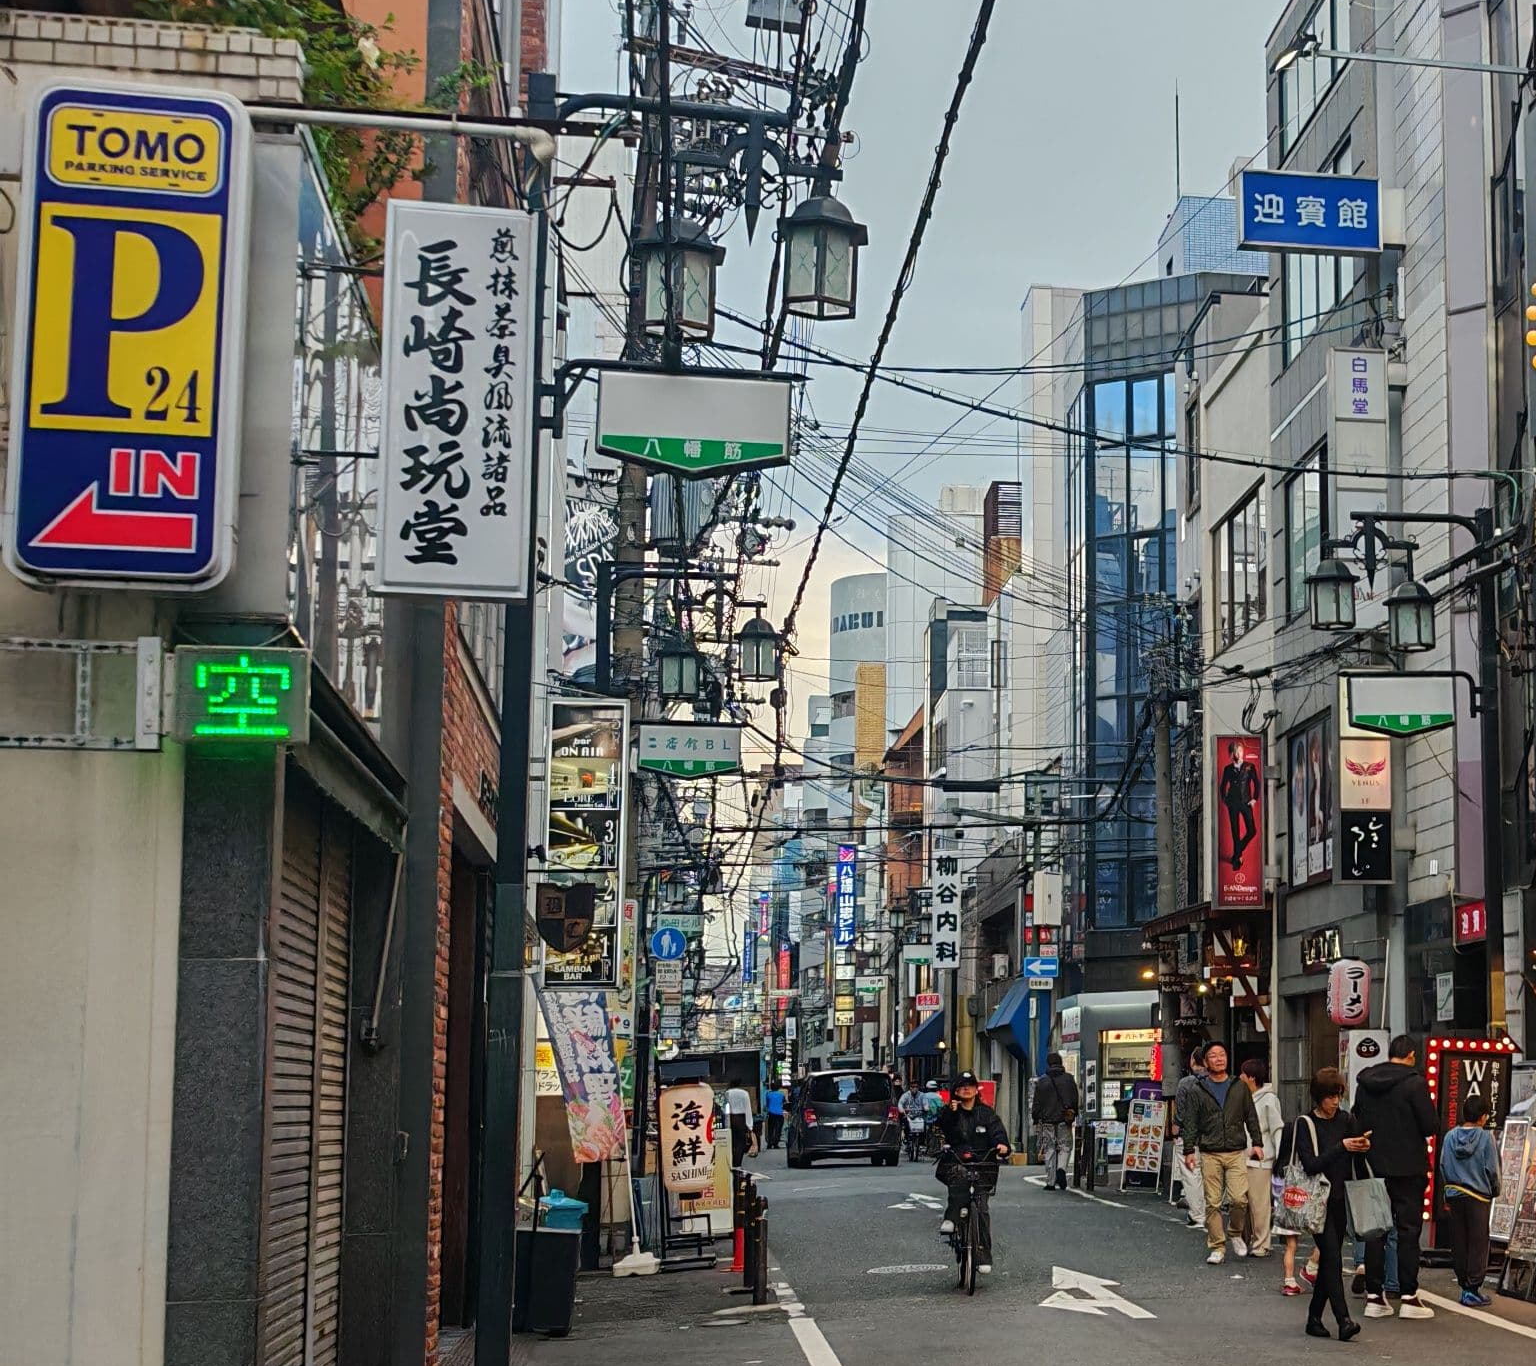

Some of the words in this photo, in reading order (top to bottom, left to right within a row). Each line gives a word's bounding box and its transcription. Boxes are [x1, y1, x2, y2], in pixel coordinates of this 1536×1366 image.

[64, 160, 136, 176] PARKING
[139, 166, 207, 182] SERVICE
[66, 123, 206, 166] TOMO
[1254, 193, 1368, 229] 迎賓館
[40, 214, 205, 419] P
[144, 366, 202, 425] 24
[480, 226, 519, 517] 煎抹茶具風流諸品
[1352, 356, 1369, 415] 白馬堂
[399, 239, 477, 566] 長崎尚玩堂
[109, 447, 200, 500] IN
[642, 436, 743, 461] 八幡筋
[196, 654, 290, 738] 空
[561, 747, 578, 757] ON
[936, 854, 959, 962] 柳谷内科
[554, 964, 592, 974] SAMBOA
[563, 971, 582, 981] BAR
[1345, 966, 1364, 1020] ラーメン
[671, 1100, 705, 1167] 海鮮
